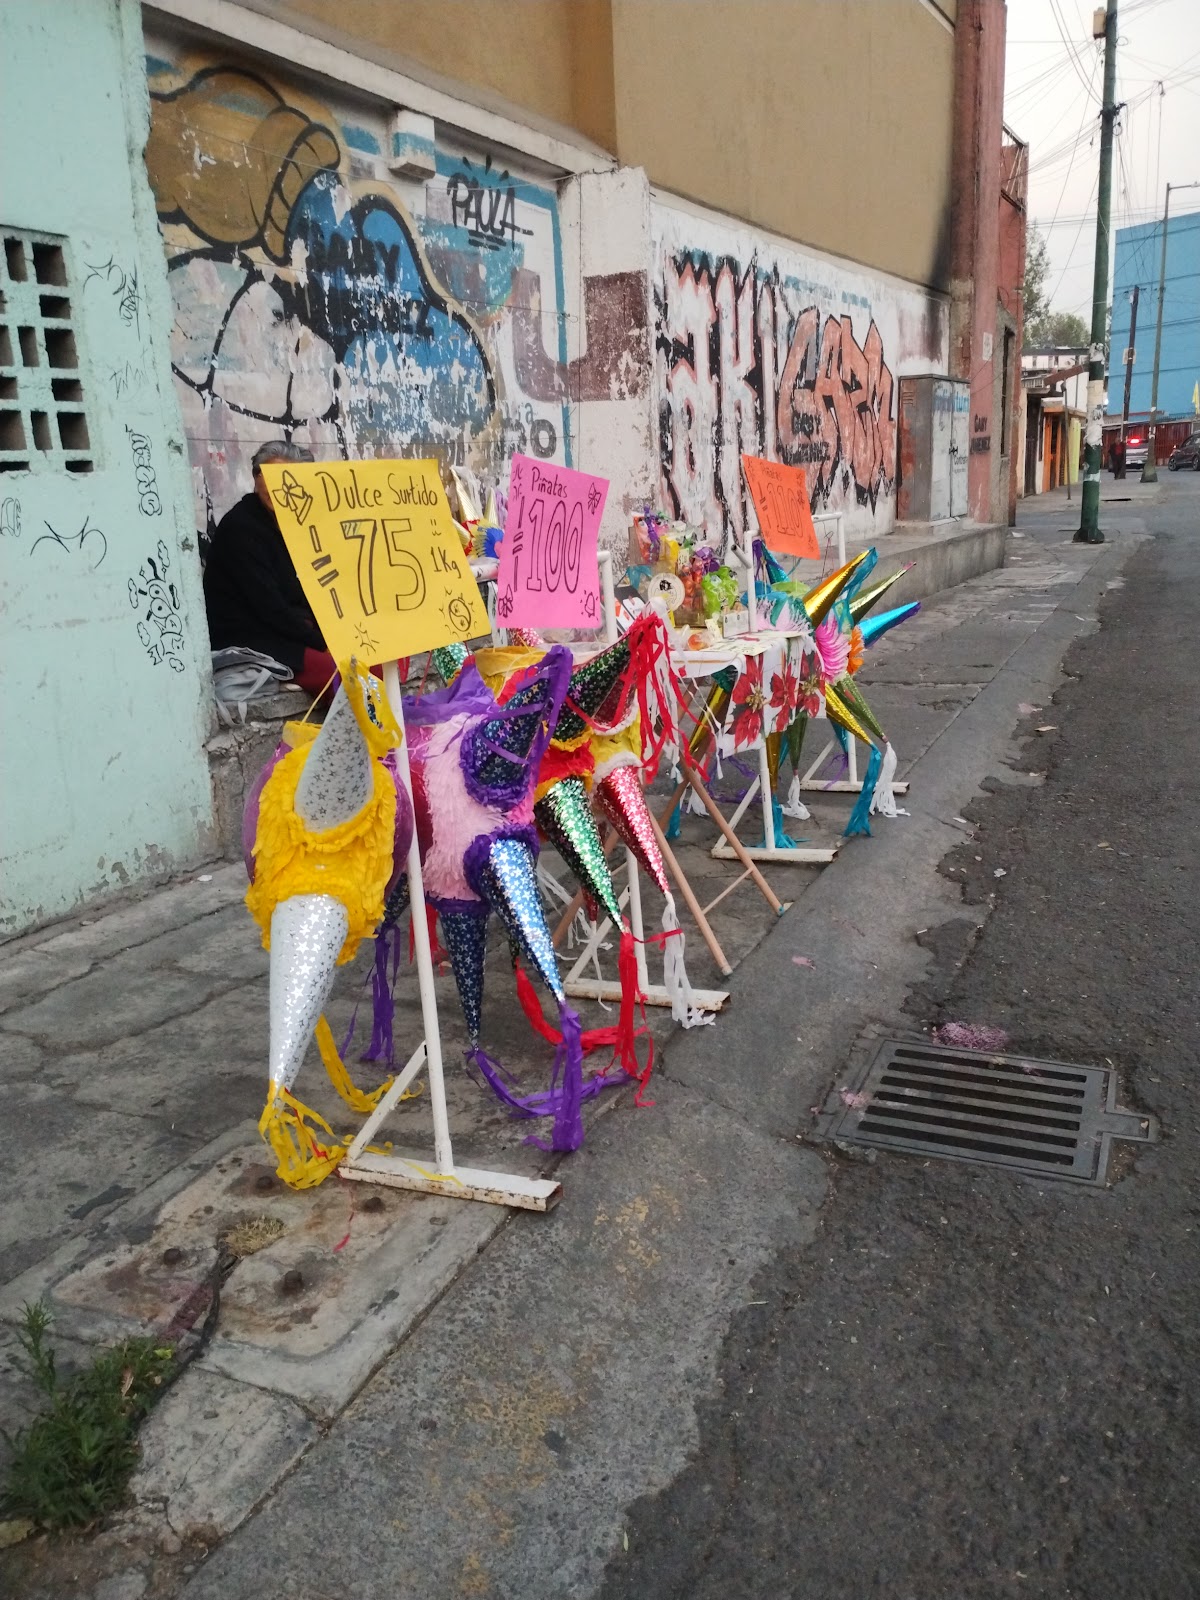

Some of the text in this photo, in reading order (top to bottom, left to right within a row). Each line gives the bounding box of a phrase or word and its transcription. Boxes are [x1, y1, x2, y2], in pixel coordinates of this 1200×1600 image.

[446, 172, 532, 252] PAULA
[314, 468, 438, 512] Dulce Surtido
[531, 466, 567, 498] Piñatas
[430, 546, 462, 578] 1Kg
